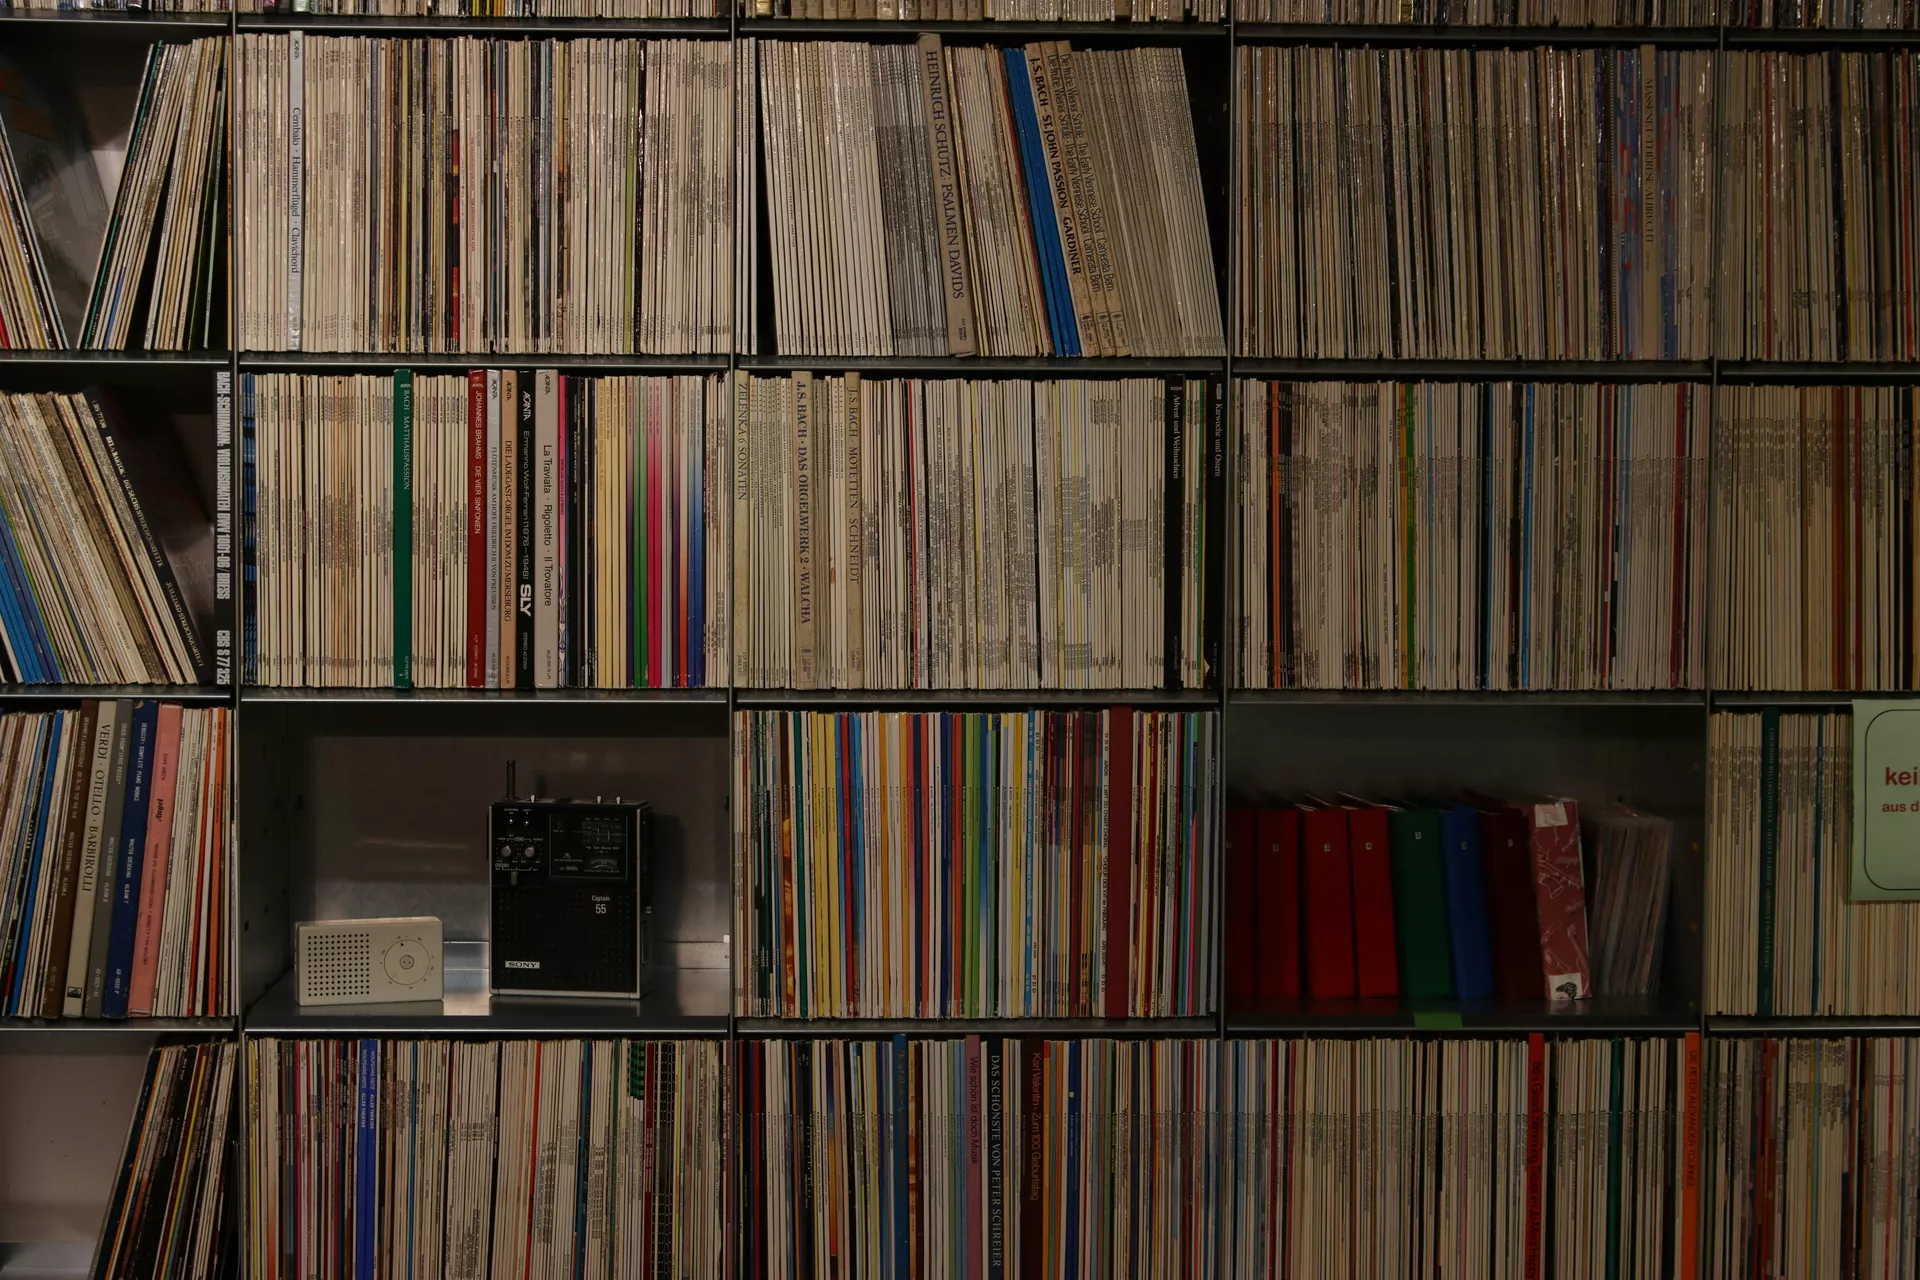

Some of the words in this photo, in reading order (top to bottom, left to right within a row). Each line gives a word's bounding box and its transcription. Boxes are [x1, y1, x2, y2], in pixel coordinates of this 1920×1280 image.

[926, 51, 944, 120] HEINRICH
[1645, 79, 1654, 133] MASSENET
[293, 107, 301, 145] Cembalo
[934, 123, 952, 180] SCHÜTZ:
[291, 156, 301, 217] Hammerflügel
[1036, 76, 1049, 106] BACH
[1052, 162, 1068, 208] PASSION
[1063, 217, 1081, 274] GARDINER
[942, 184, 959, 246] PSALMEN
[1645, 189, 1654, 245] ALBRECHT
[292, 227, 301, 273] Clavichord
[949, 250, 964, 299] DAVIDS
[523, 391, 531, 421] ACANTA
[738, 383, 747, 435] ZELENKA
[798, 404, 807, 438] BACH
[849, 407, 858, 437] BACH
[403, 416, 411, 490] MATTHÄUSPASSION
[544, 445, 552, 456] La
[798, 447, 807, 470] DAS
[217, 448, 230, 511] VIOLINSONATEN
[544, 458, 552, 493] Traviata
[738, 446, 747, 500] SONATEN
[849, 447, 858, 508] MOTETTEN
[217, 513, 230, 533] BWV
[542, 505, 552, 545] Rigoletto
[799, 474, 809, 554] ORGELWERK
[505, 529, 512, 538] IM
[849, 518, 859, 584] SCHNEIDT
[505, 560, 512, 572] ZU
[520, 584, 531, 617] SLY
[544, 564, 552, 606] Trovatore
[801, 572, 810, 624] WALCHA
[217, 630, 230, 647] CBS
[98, 724, 111, 759] VERDI
[92, 770, 105, 815] OTELLO
[155, 798, 164, 822] Angel
[1882, 803, 1906, 812] aus
[82, 826, 99, 892] BARBIROLLI
[595, 904, 606, 914] 55
[970, 1057, 978, 1073] Wie
[991, 1055, 1000, 1076] DAS
[1032, 1053, 1041, 1070] Karl
[1689, 1066, 1698, 1093] PETER
[970, 1075, 979, 1101] schön
[1032, 1073, 1041, 1105] Valentin
[970, 1104, 979, 1113] ist
[970, 1115, 979, 1137] doch
[991, 1080, 1002, 1140] SCHÖNSTE
[1032, 1112, 1040, 1132] Zum
[1688, 1094, 1697, 1148] ALEXANDER
[971, 1140, 979, 1164] Musik
[992, 1143, 1000, 1166] VON
[1687, 1150, 1696, 1190] TOURNEE
[992, 1170, 1001, 1205] PETER
[1030, 1152, 1040, 1200] Geburtstag
[992, 1209, 1001, 1267] SCHREIER
